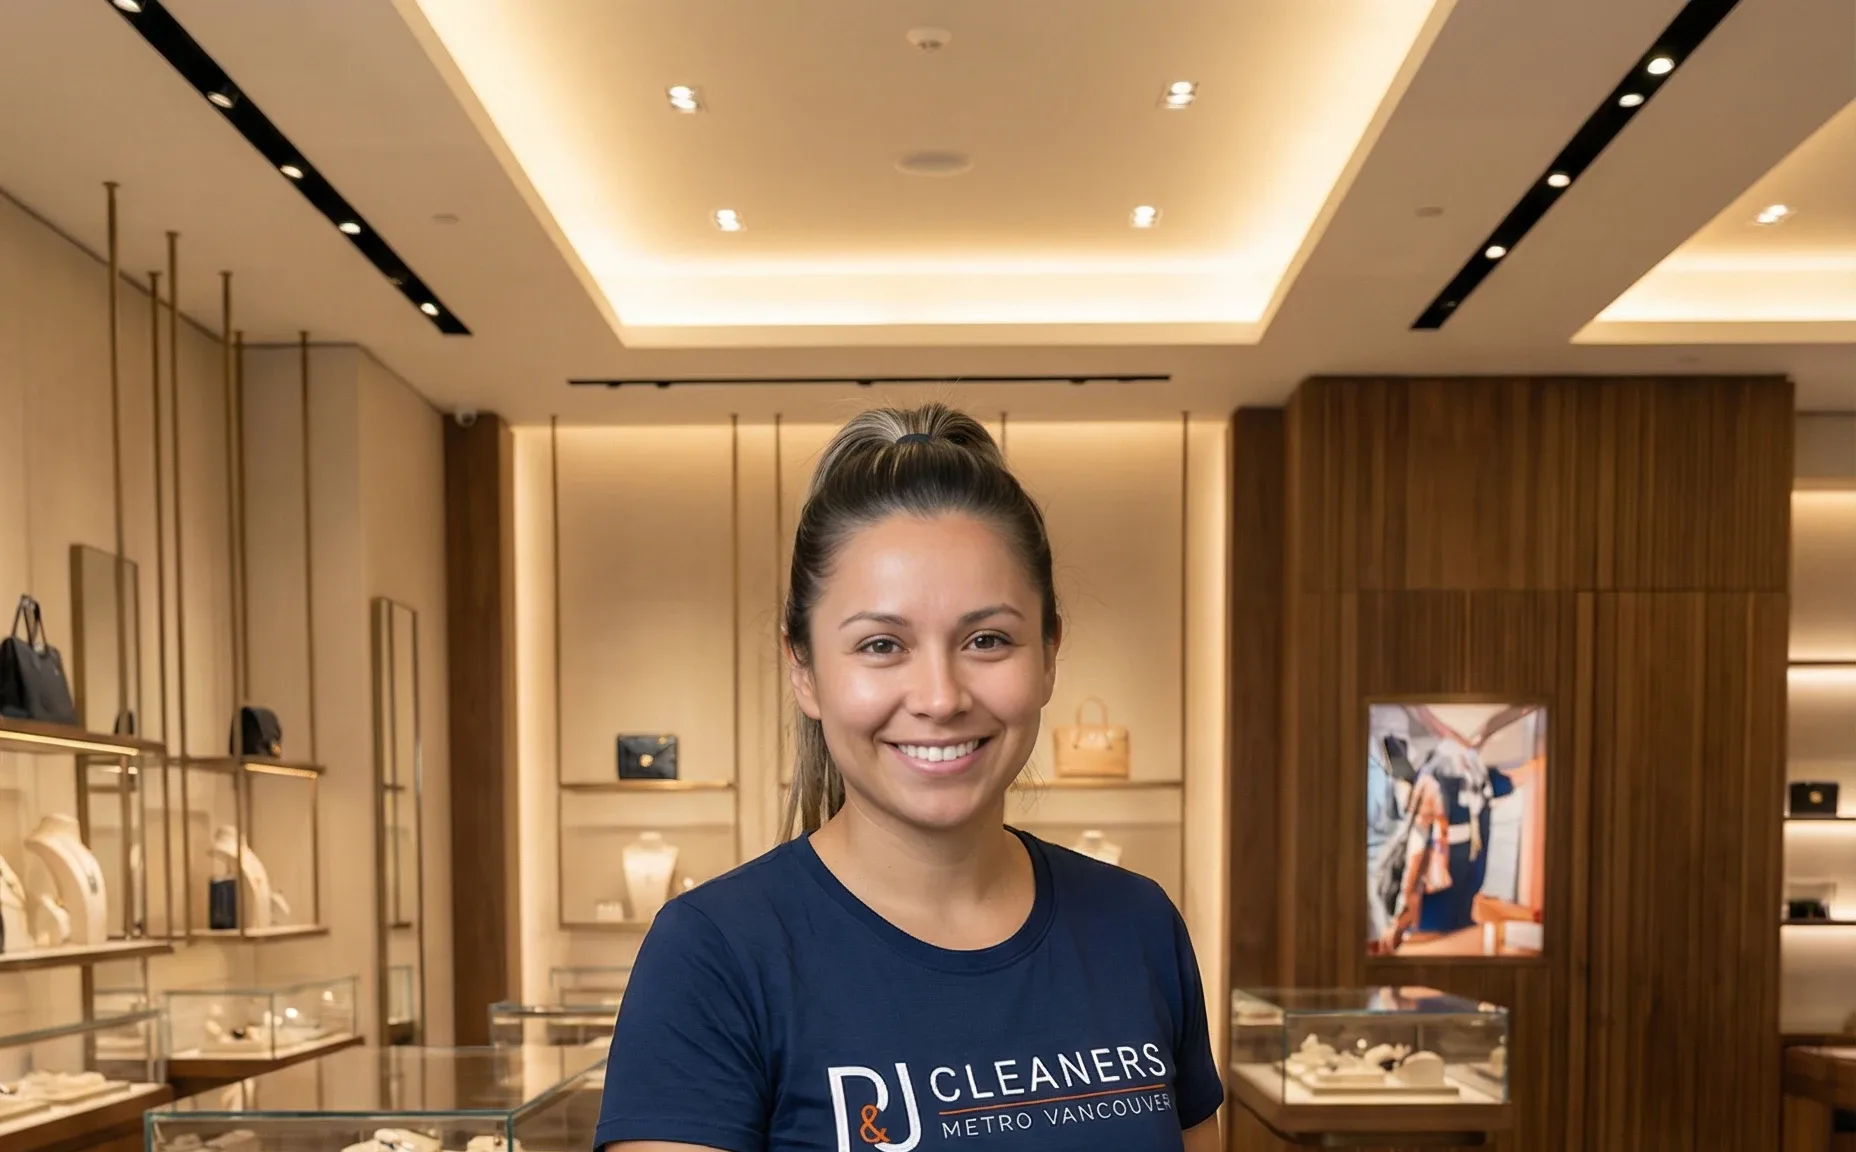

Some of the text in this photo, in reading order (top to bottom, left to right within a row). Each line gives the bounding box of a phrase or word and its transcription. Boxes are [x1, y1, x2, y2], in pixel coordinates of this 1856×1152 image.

[931, 1043, 1166, 1102] CLEANERS
[942, 1093, 1172, 1139] METRO VANCOUVER
